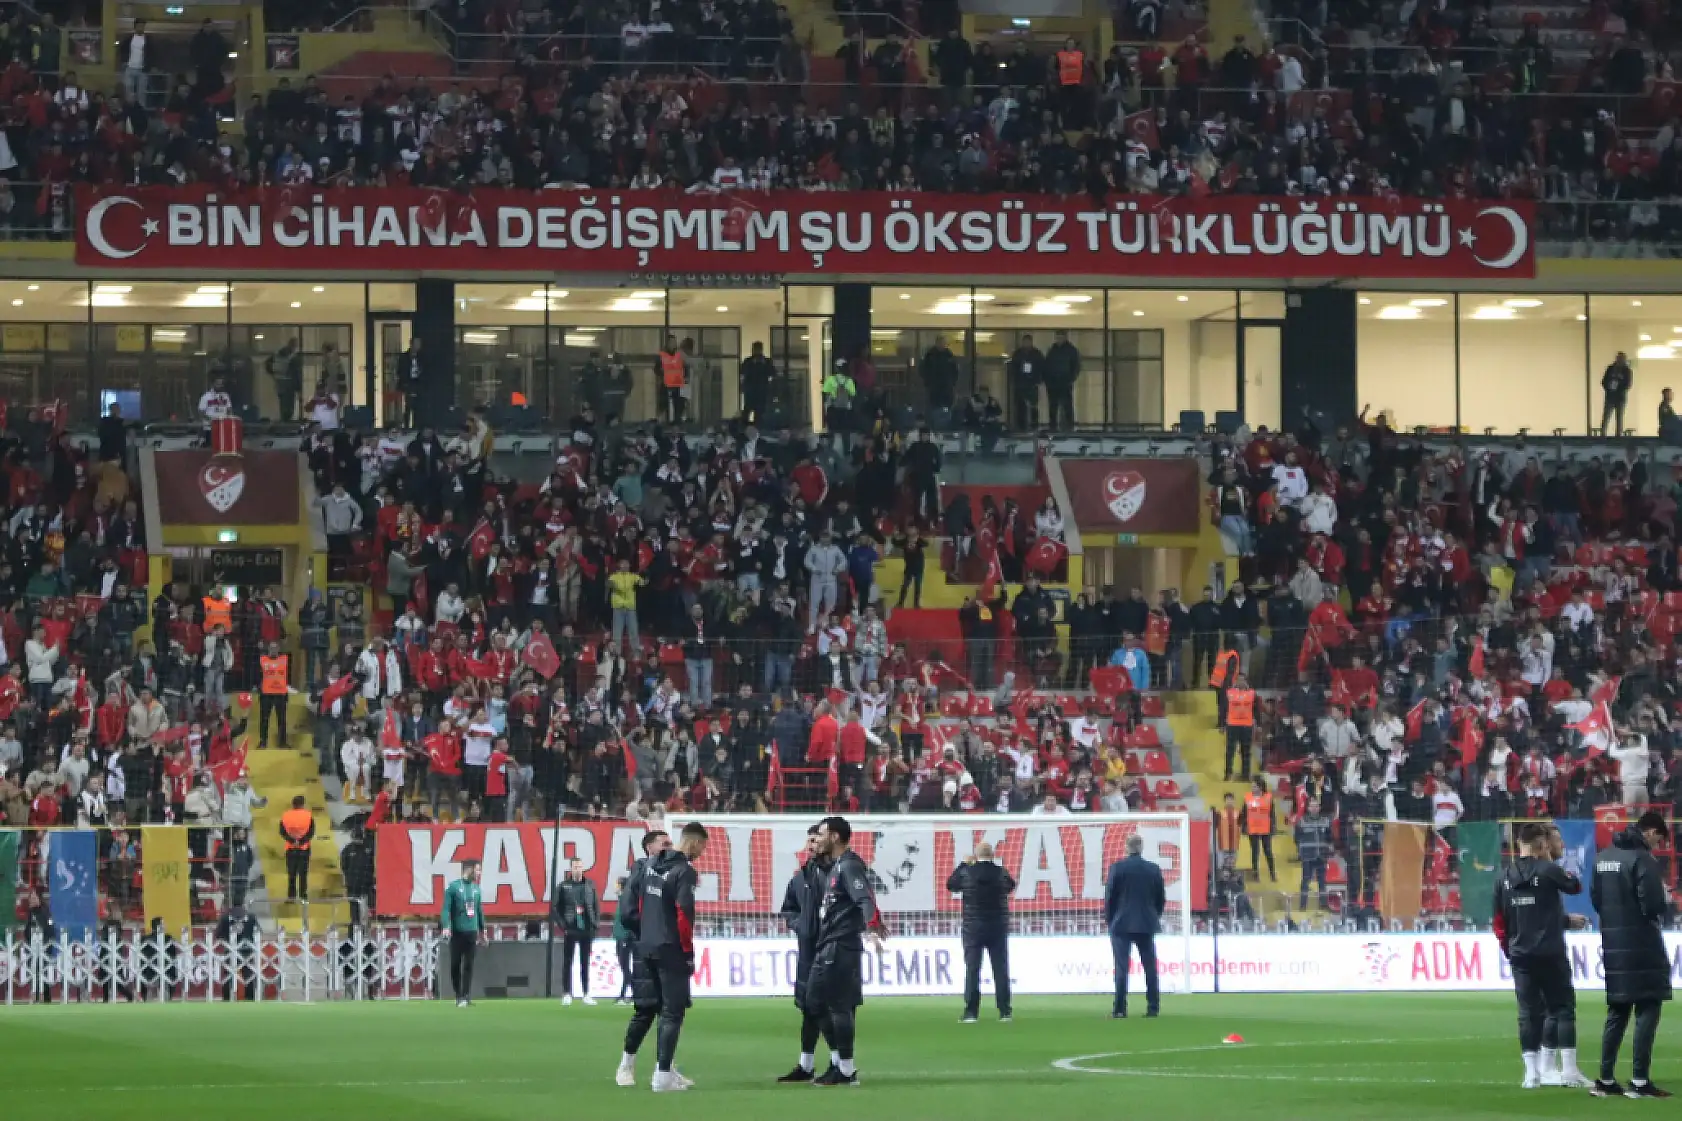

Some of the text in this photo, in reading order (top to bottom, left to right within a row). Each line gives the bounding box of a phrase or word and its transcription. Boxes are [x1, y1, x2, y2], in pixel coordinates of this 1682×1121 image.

[168, 194, 1451, 268] BİN CİHANA DEĞİŞMEM ŞU ÖKSÜZ TÜRKLÜĞÜMÜ
[1411, 940, 1483, 981] ADM
